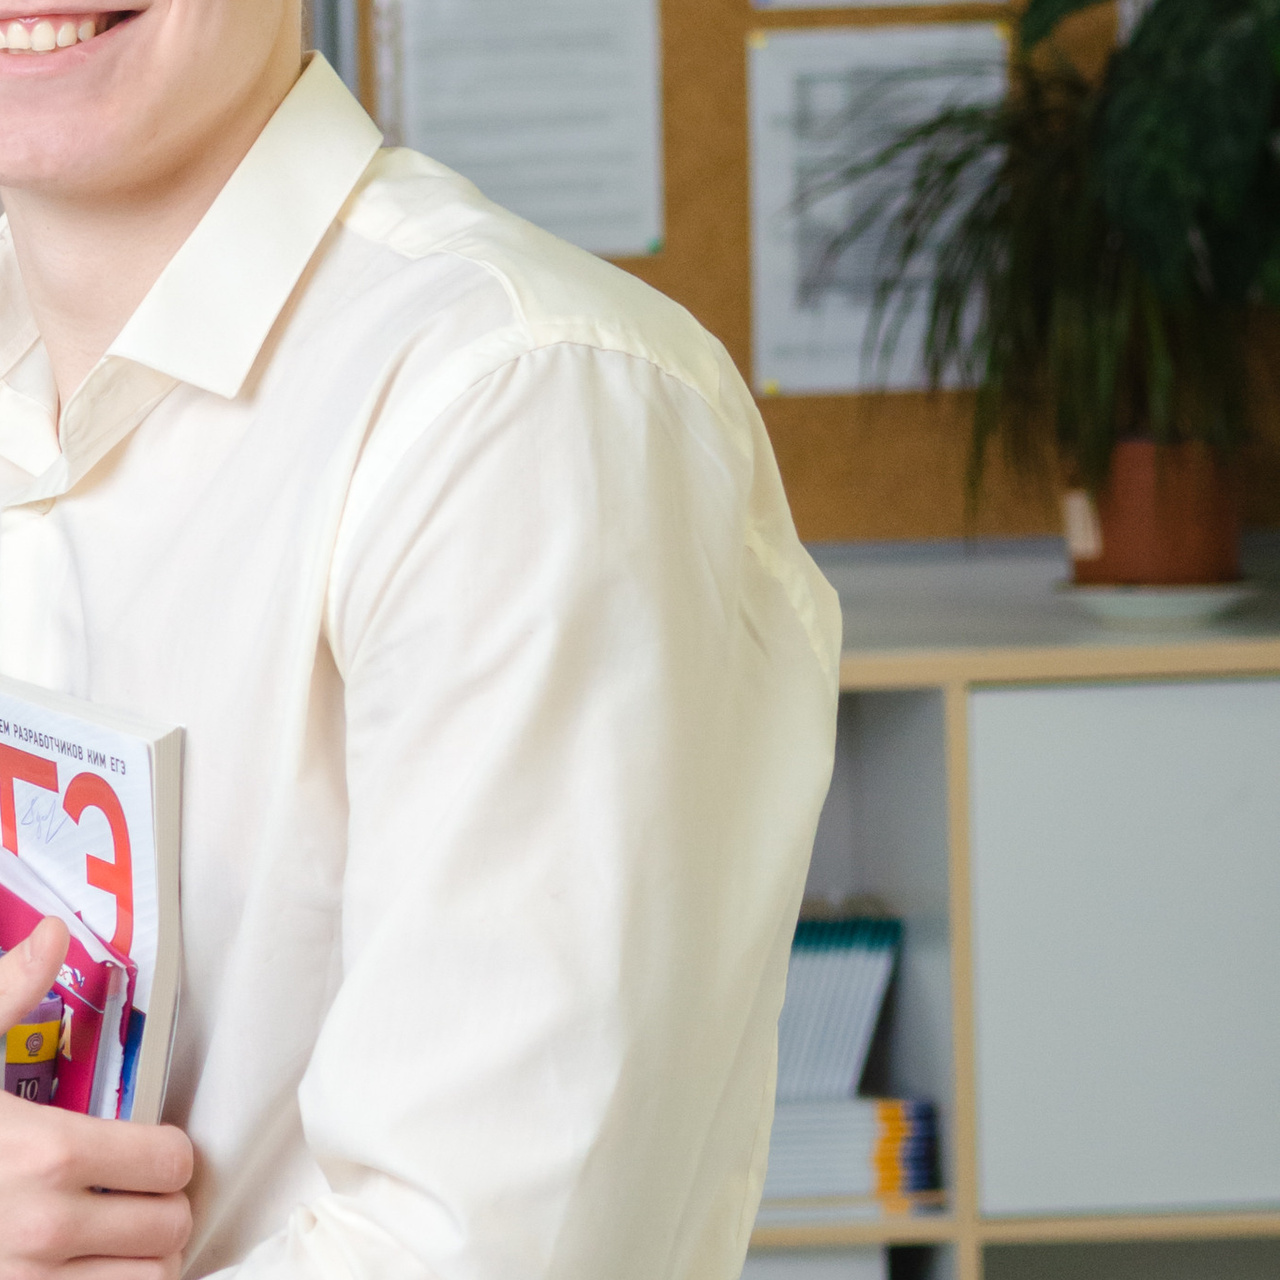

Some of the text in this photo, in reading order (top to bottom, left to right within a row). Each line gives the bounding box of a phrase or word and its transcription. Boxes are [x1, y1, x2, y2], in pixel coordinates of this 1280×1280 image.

[13, 723, 84, 761] РАЗРАБОТЧИКОВ
[87, 749, 107, 769] КИМ
[110, 756, 126, 775] ЕГЭ
[18, 1079, 39, 1101] 10
